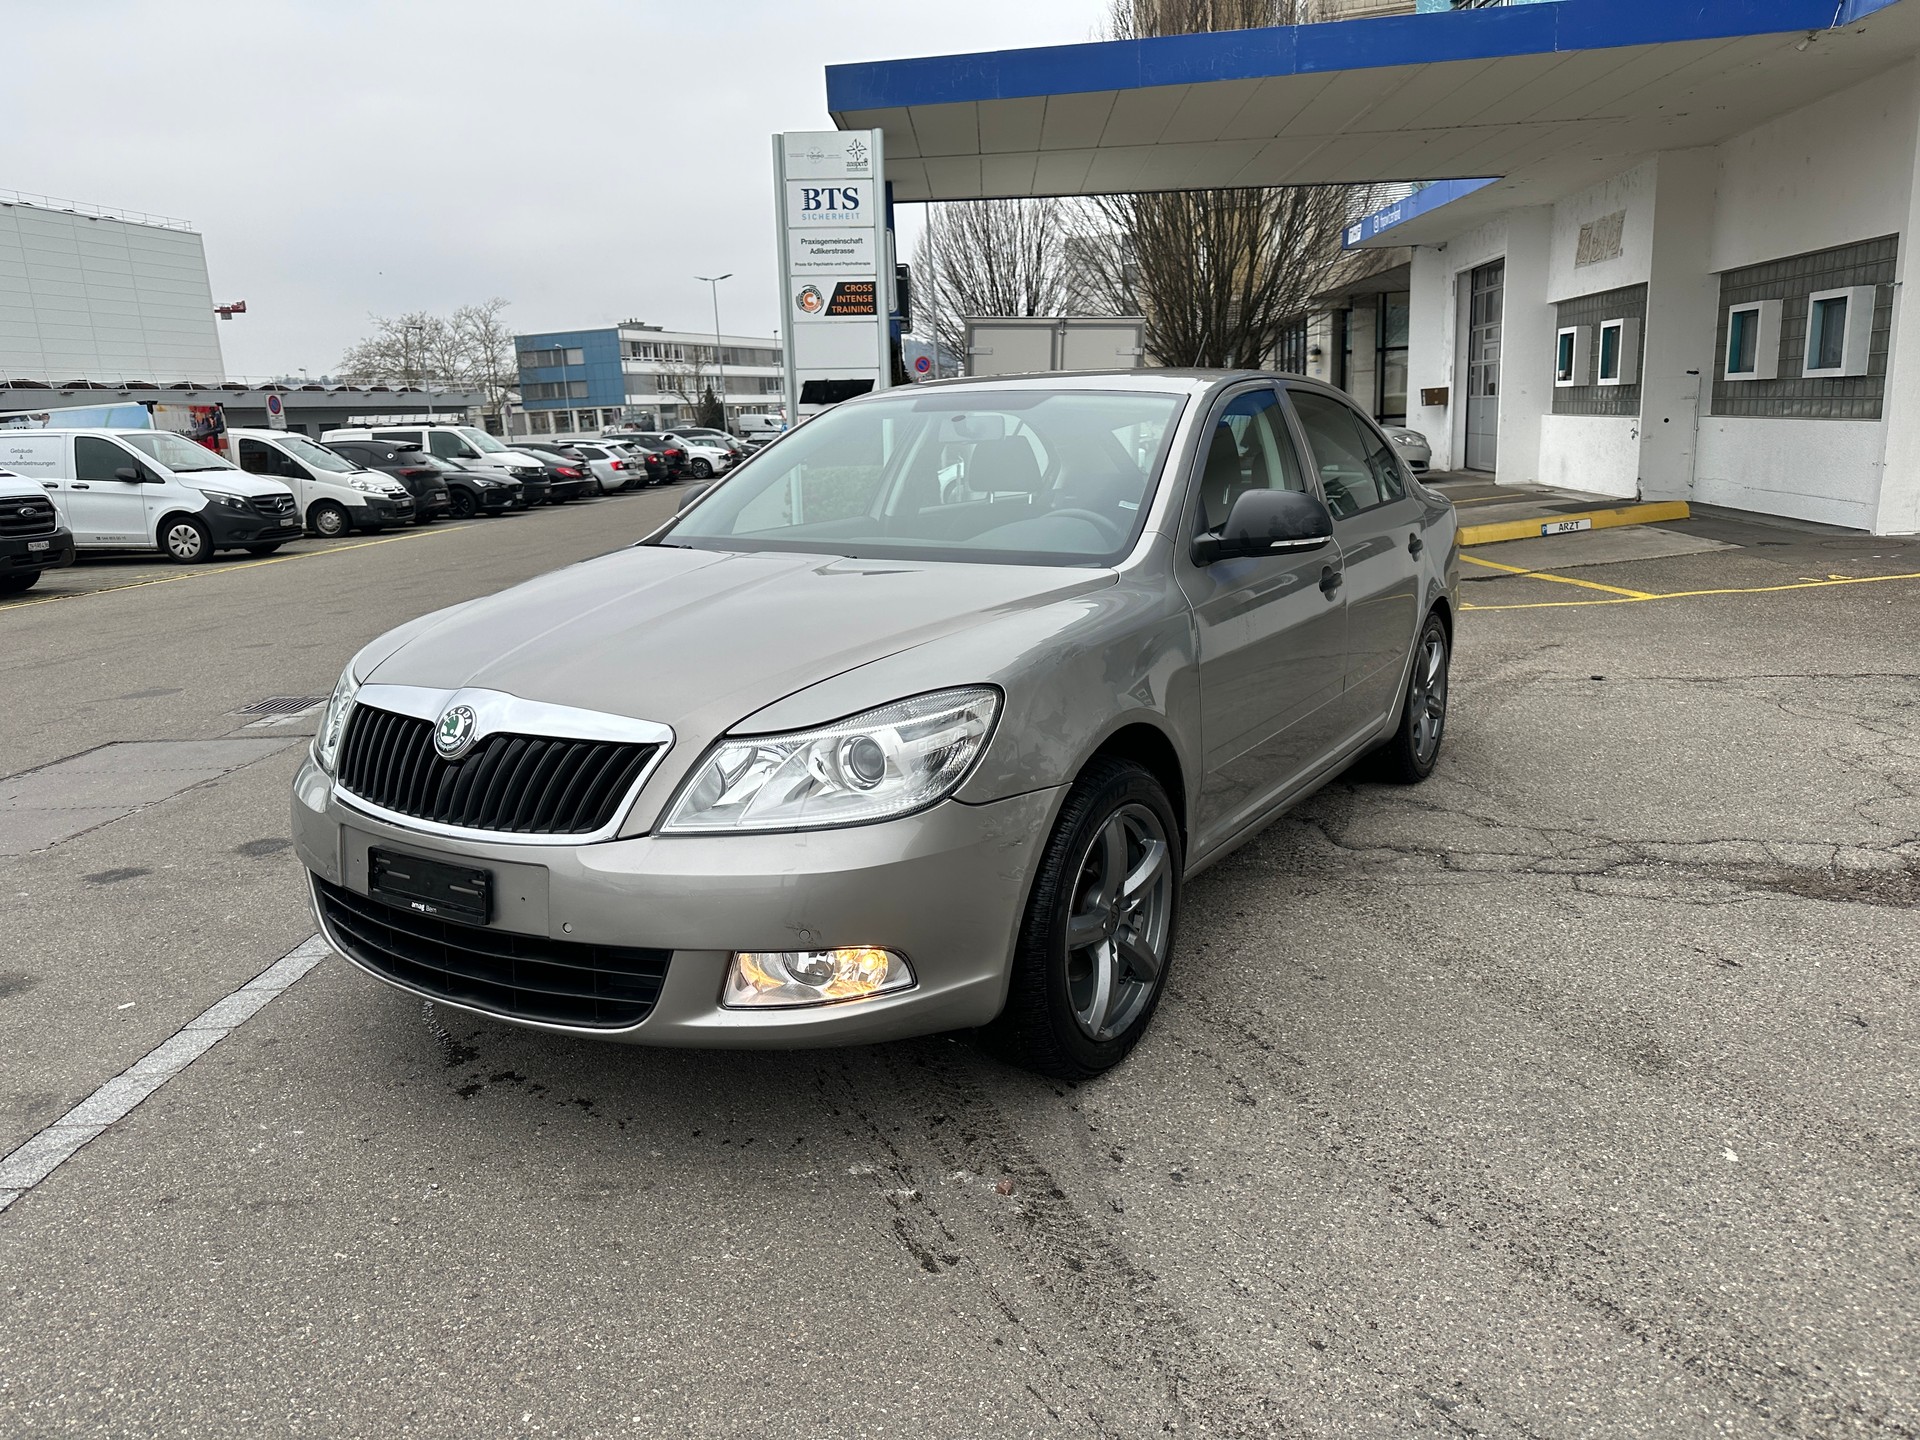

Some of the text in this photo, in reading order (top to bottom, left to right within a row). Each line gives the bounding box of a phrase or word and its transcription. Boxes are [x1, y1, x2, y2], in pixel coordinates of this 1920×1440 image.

[801, 187, 860, 211] BTS
[801, 213, 861, 221] SICHERHEIT
[801, 238, 863, 246] Praxisgemeinschaft
[844, 284, 873, 292] CROSS
[836, 295, 873, 303] INTENSE
[832, 305, 873, 313] TRAINING
[1558, 521, 1579, 531] ARZT
